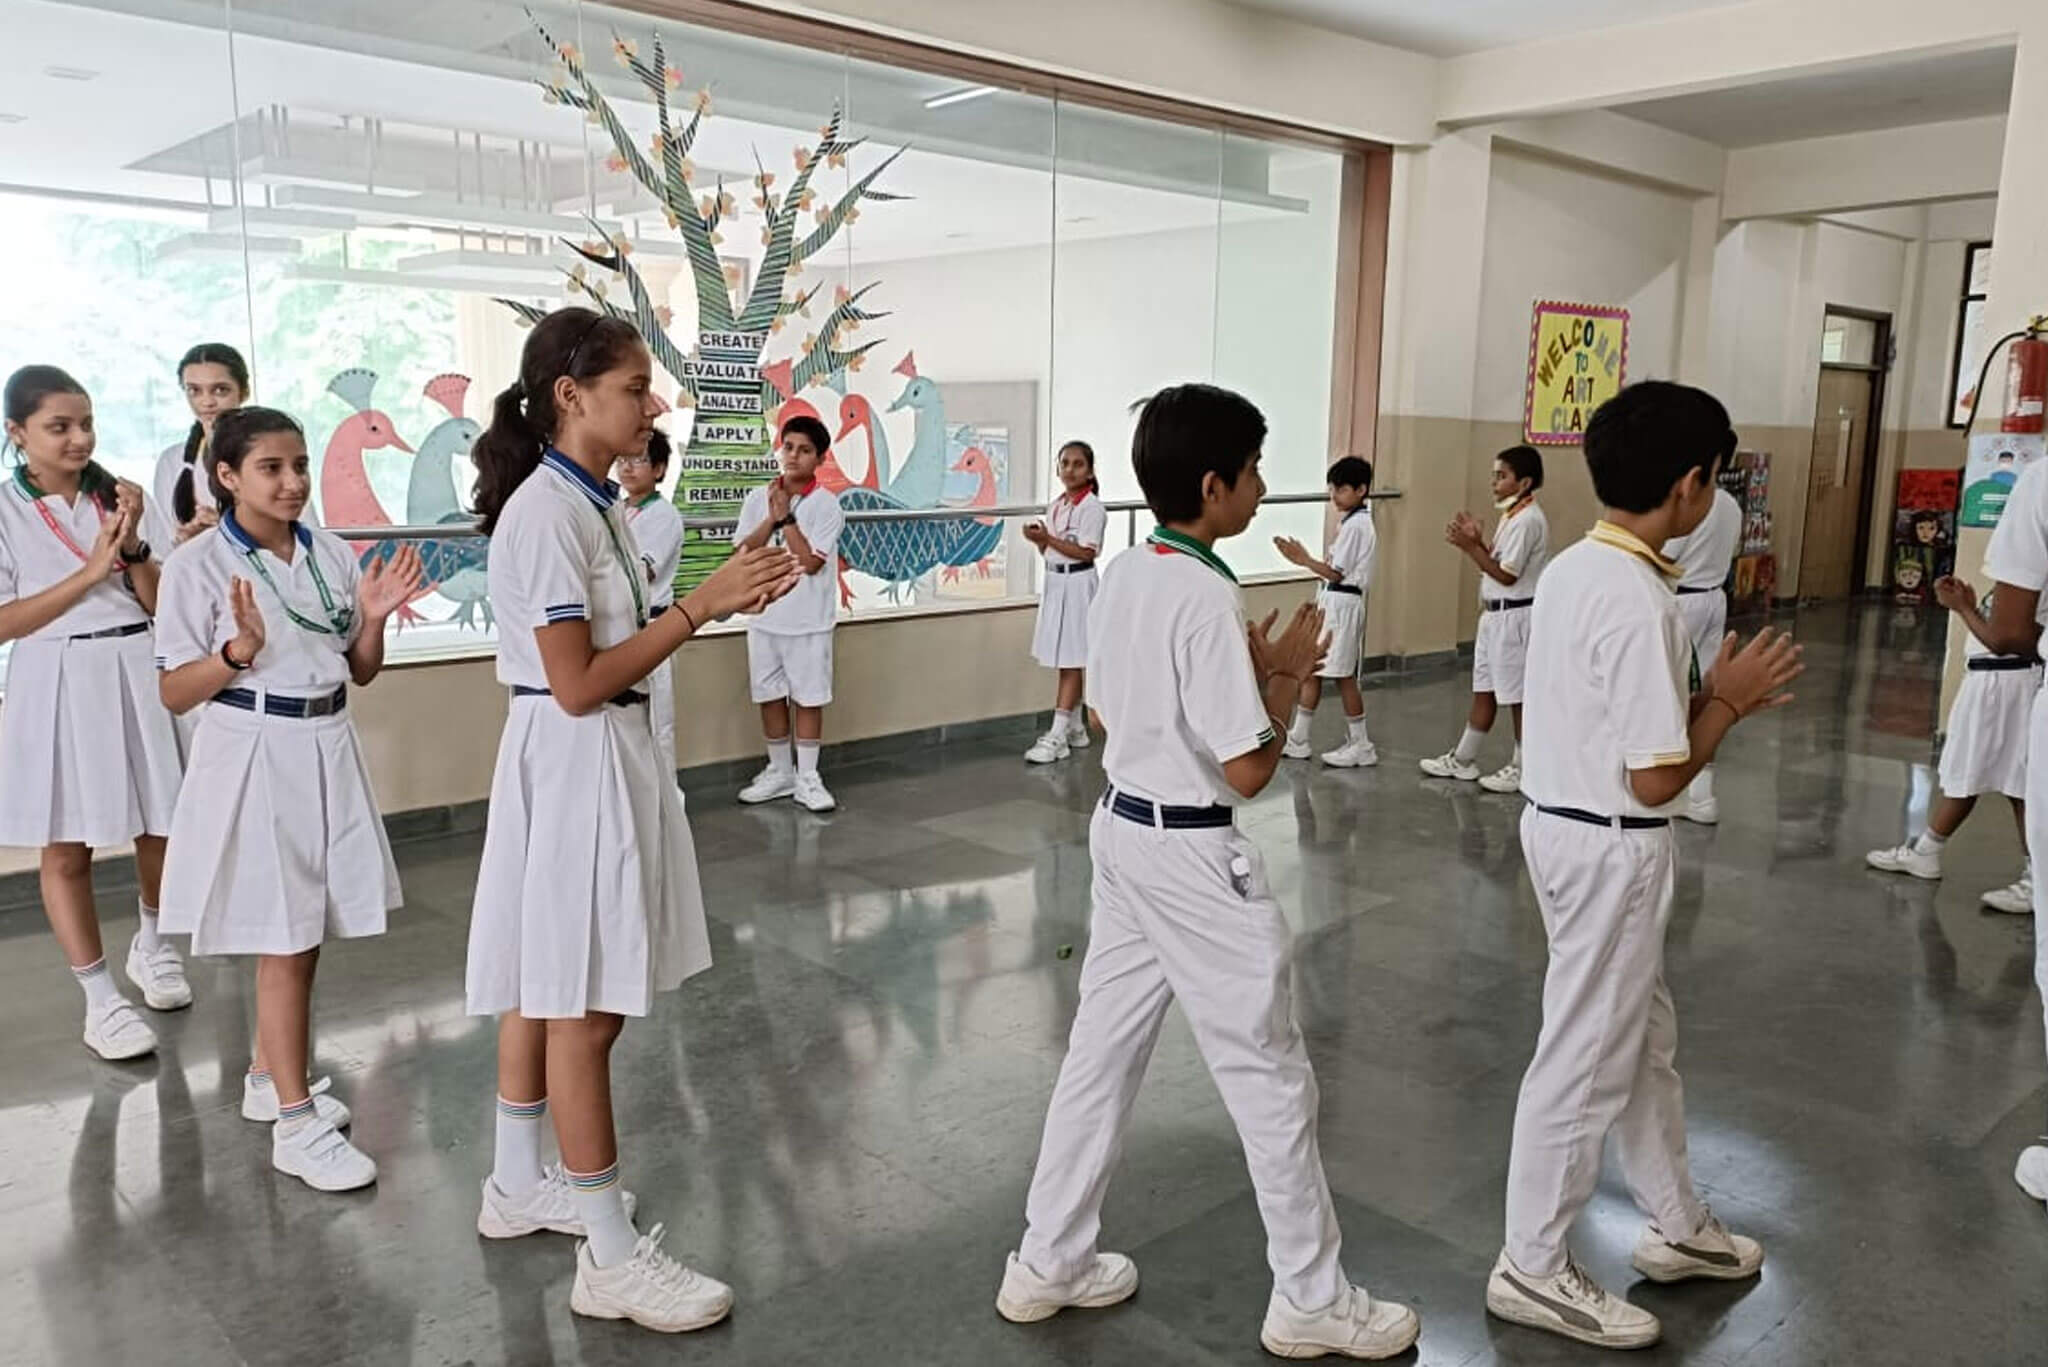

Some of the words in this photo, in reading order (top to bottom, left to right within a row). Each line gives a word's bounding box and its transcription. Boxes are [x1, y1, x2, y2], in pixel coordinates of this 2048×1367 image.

[1537, 319, 1619, 387] WELCOME
[684, 362, 766, 380] EVALUATE
[1575, 351, 1589, 374] TO
[1562, 376, 1595, 404] ART
[702, 395, 758, 409] ANALYZE
[705, 427, 754, 440] APPLY
[682, 458, 779, 472] UNDERSTAND
